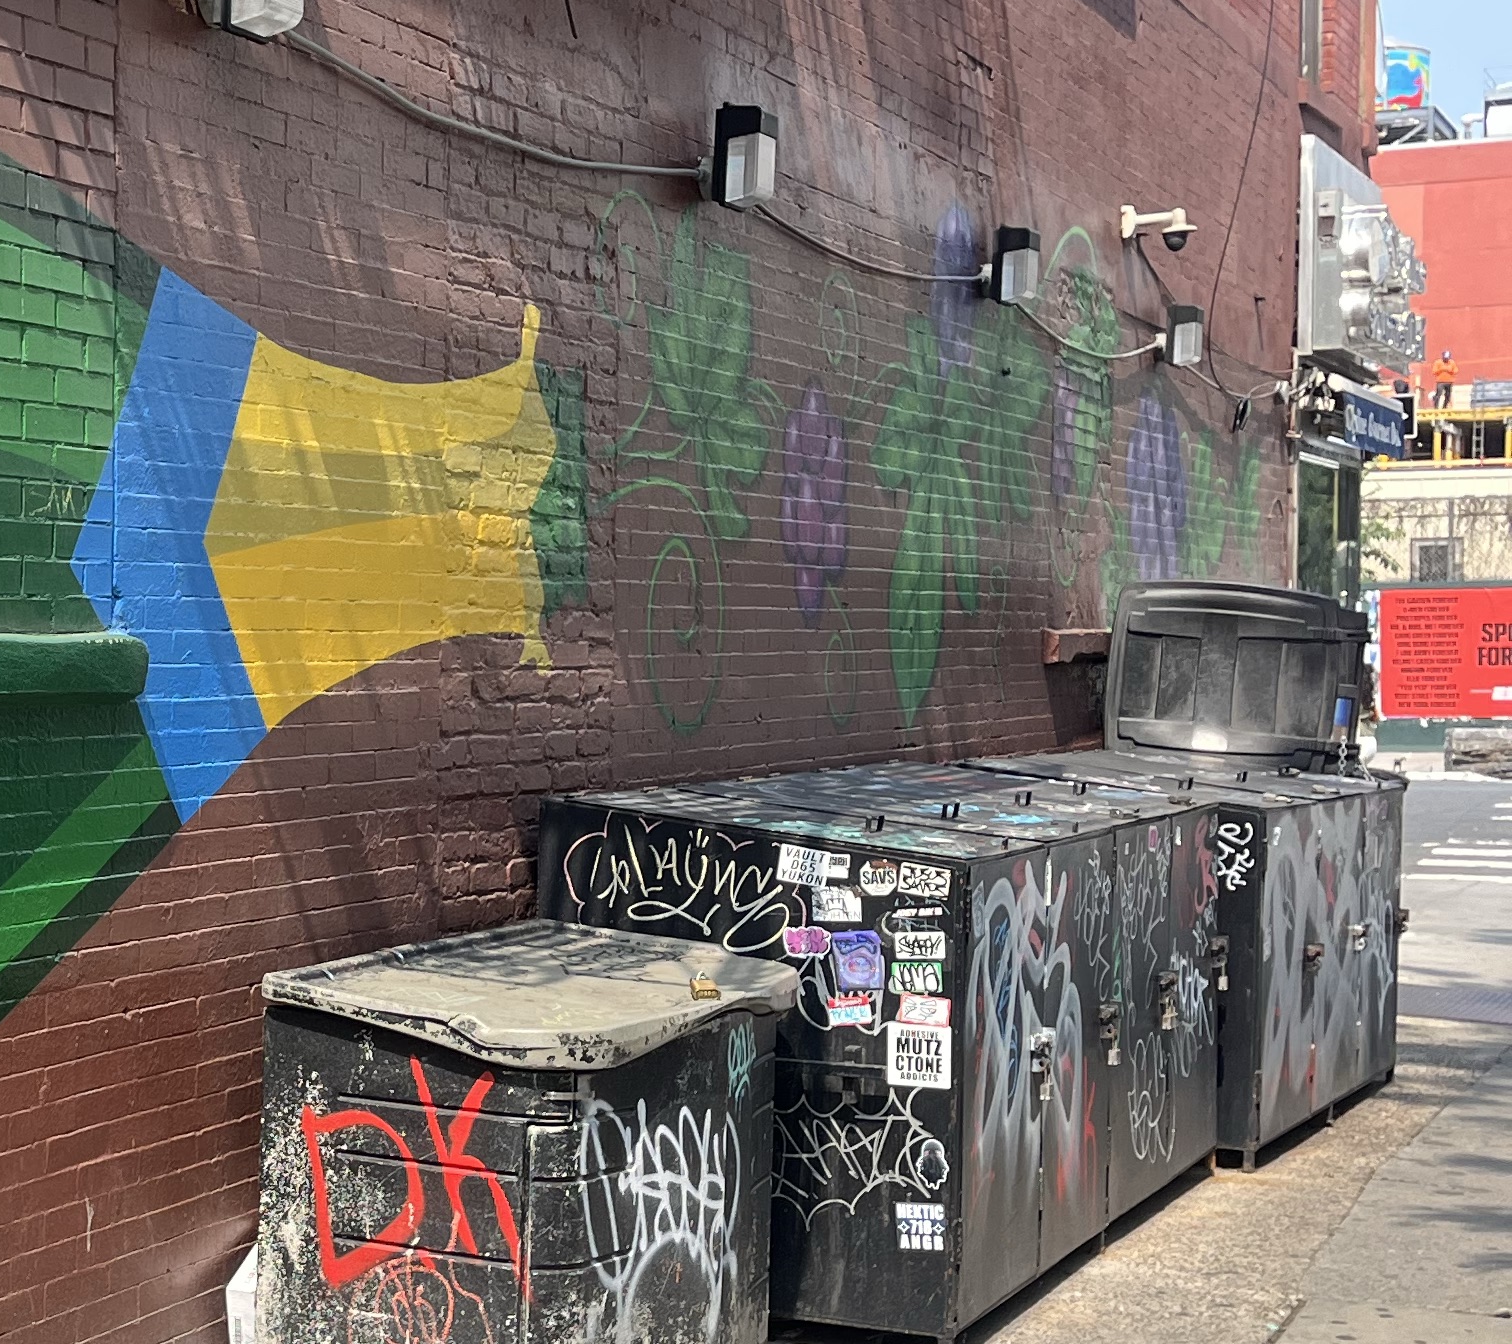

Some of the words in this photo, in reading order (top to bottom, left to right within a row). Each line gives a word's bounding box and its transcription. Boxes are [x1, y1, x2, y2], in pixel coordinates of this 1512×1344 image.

[1481, 623, 1512, 642] SP
[786, 847, 826, 864] VAULT
[781, 868, 824, 886] YUKON
[900, 1028, 939, 1039] ADHESIVE
[896, 1037, 943, 1056] MUTZ
[895, 1055, 943, 1074] CTONE
[900, 1072, 939, 1082] ADDICTS
